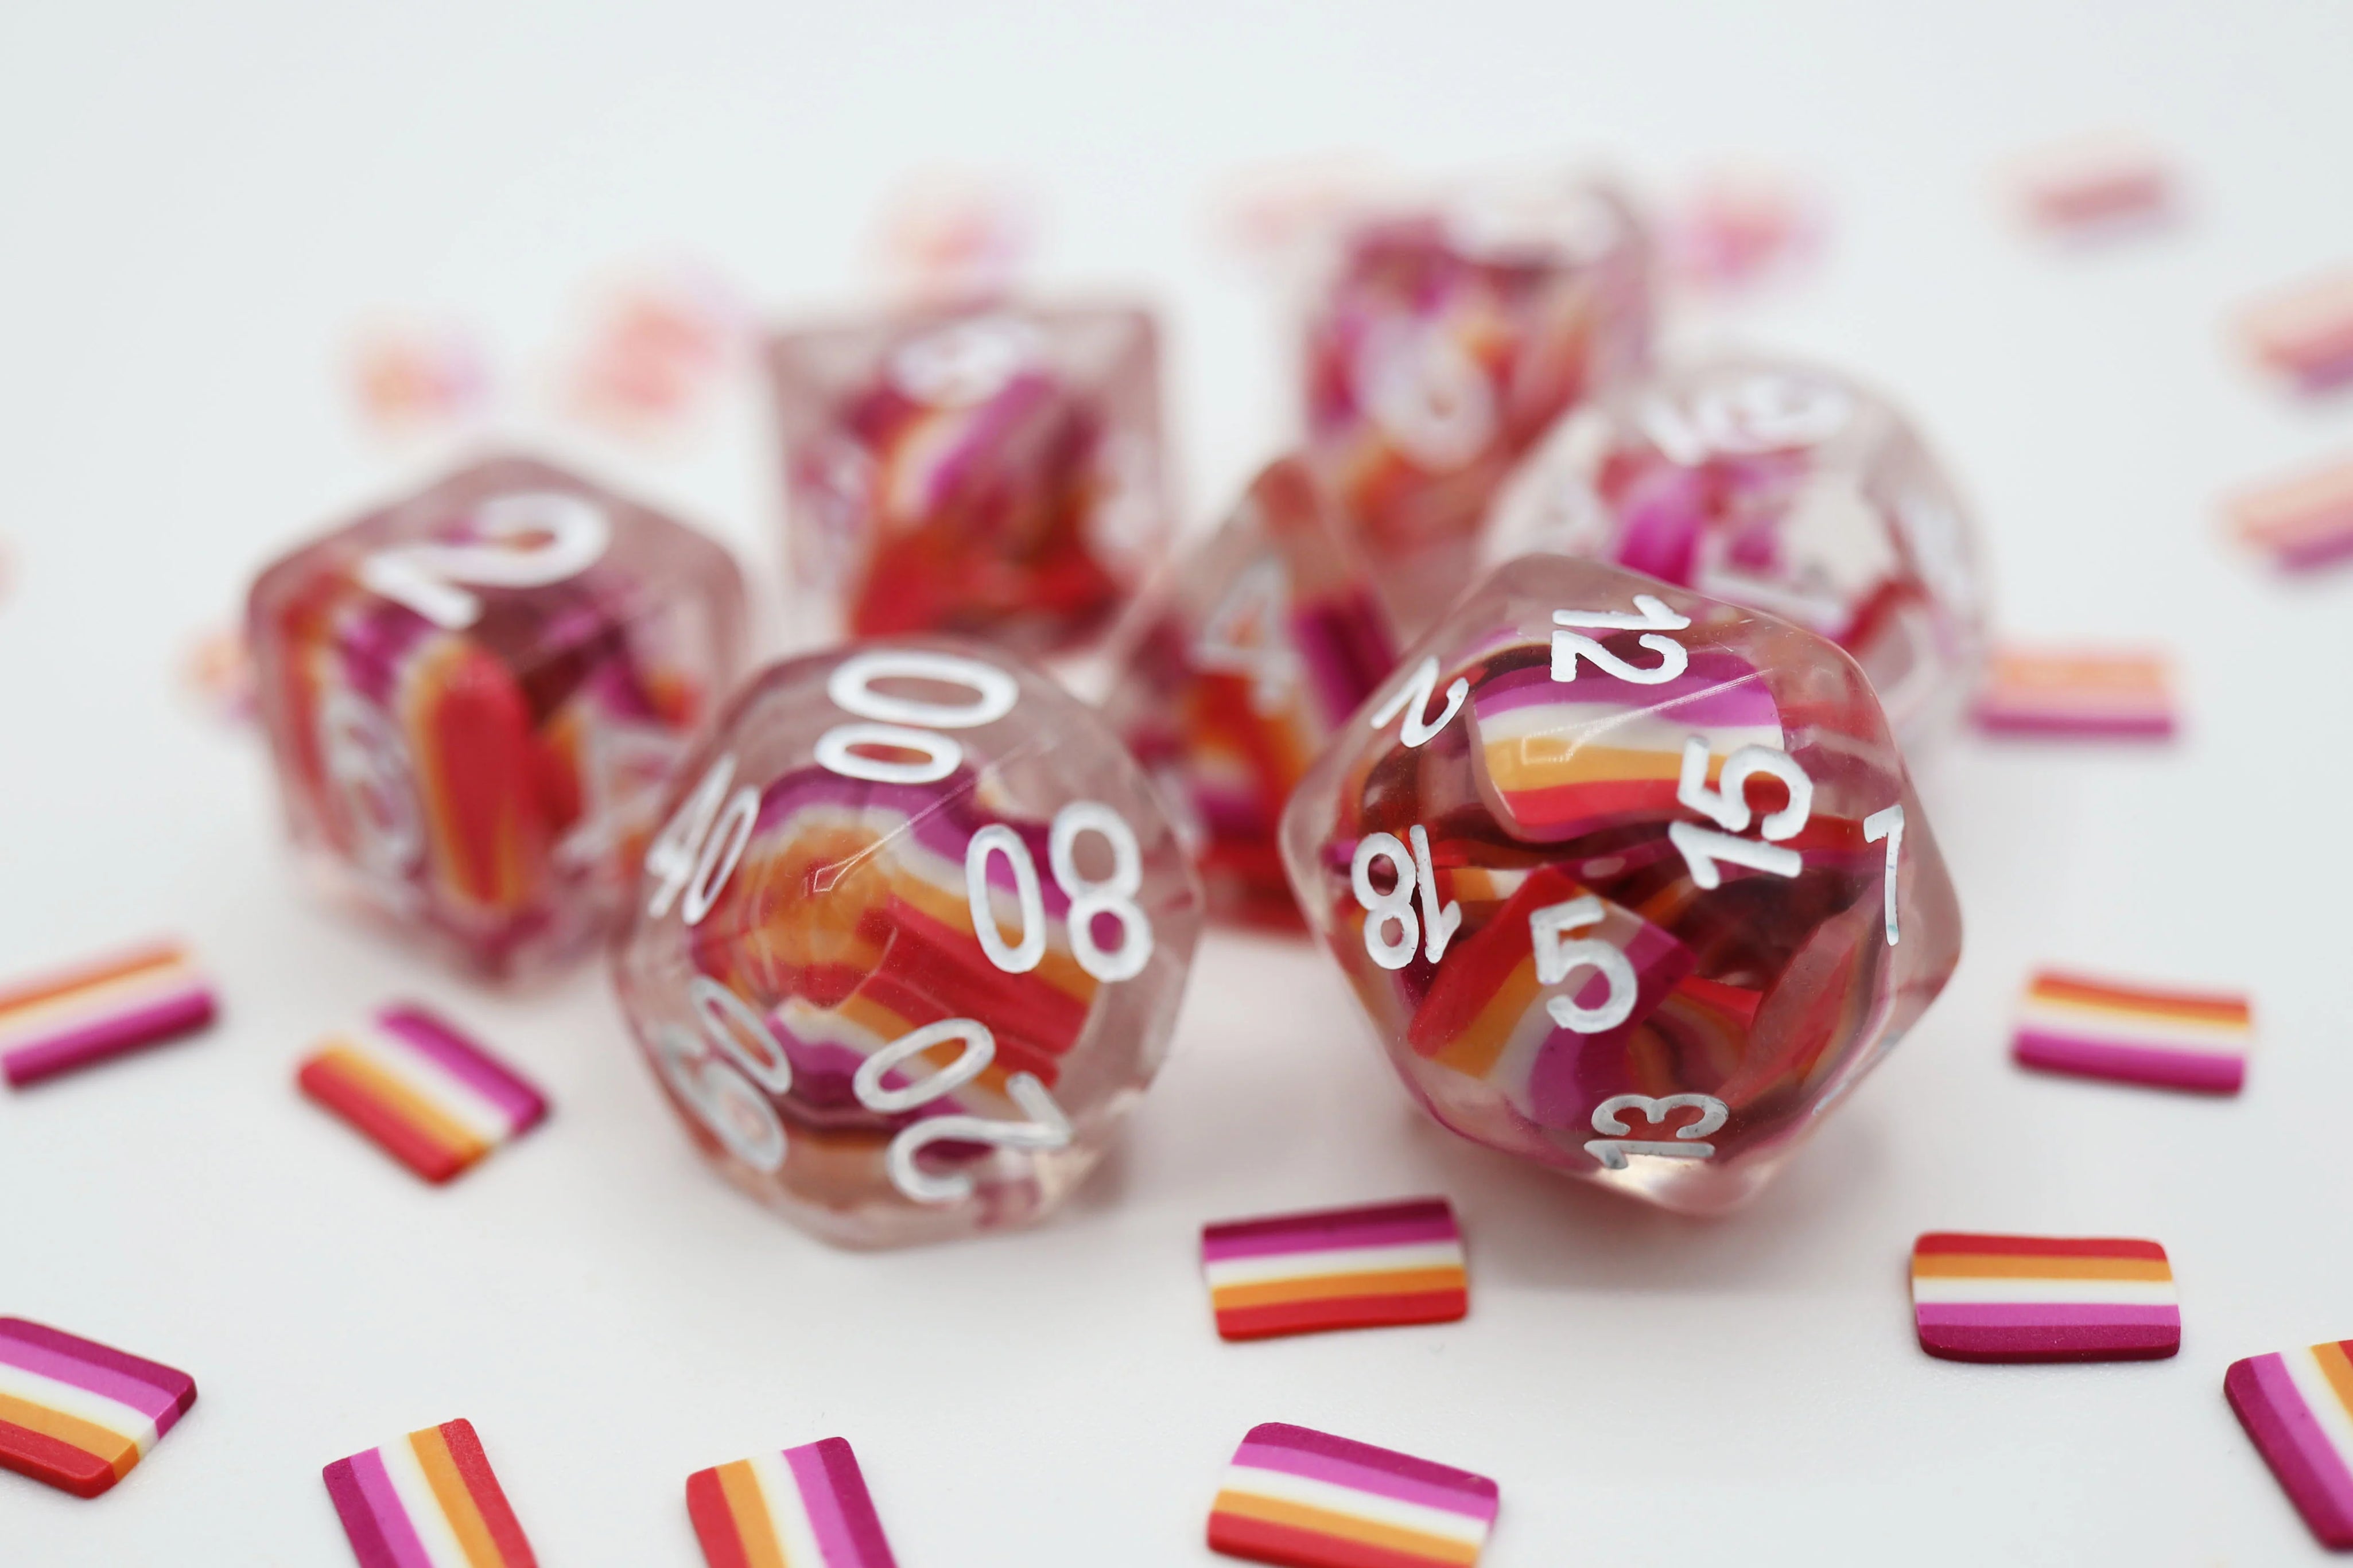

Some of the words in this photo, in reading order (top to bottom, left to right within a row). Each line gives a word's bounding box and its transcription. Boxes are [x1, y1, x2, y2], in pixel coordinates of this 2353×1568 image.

[1187, 558, 1300, 717] 4
[1370, 655, 1469, 748] 2
[1551, 594, 1692, 685] 12
[813, 649, 1020, 784] 00
[644, 750, 762, 926] 40
[1668, 736, 1814, 890] 15
[965, 800, 1154, 983] 80
[1350, 824, 1462, 970] 18
[1529, 894, 1638, 1034] 5
[658, 974, 793, 1172] 60
[852, 1017, 1078, 1203] 20
[1583, 1092, 1729, 1171] 13
